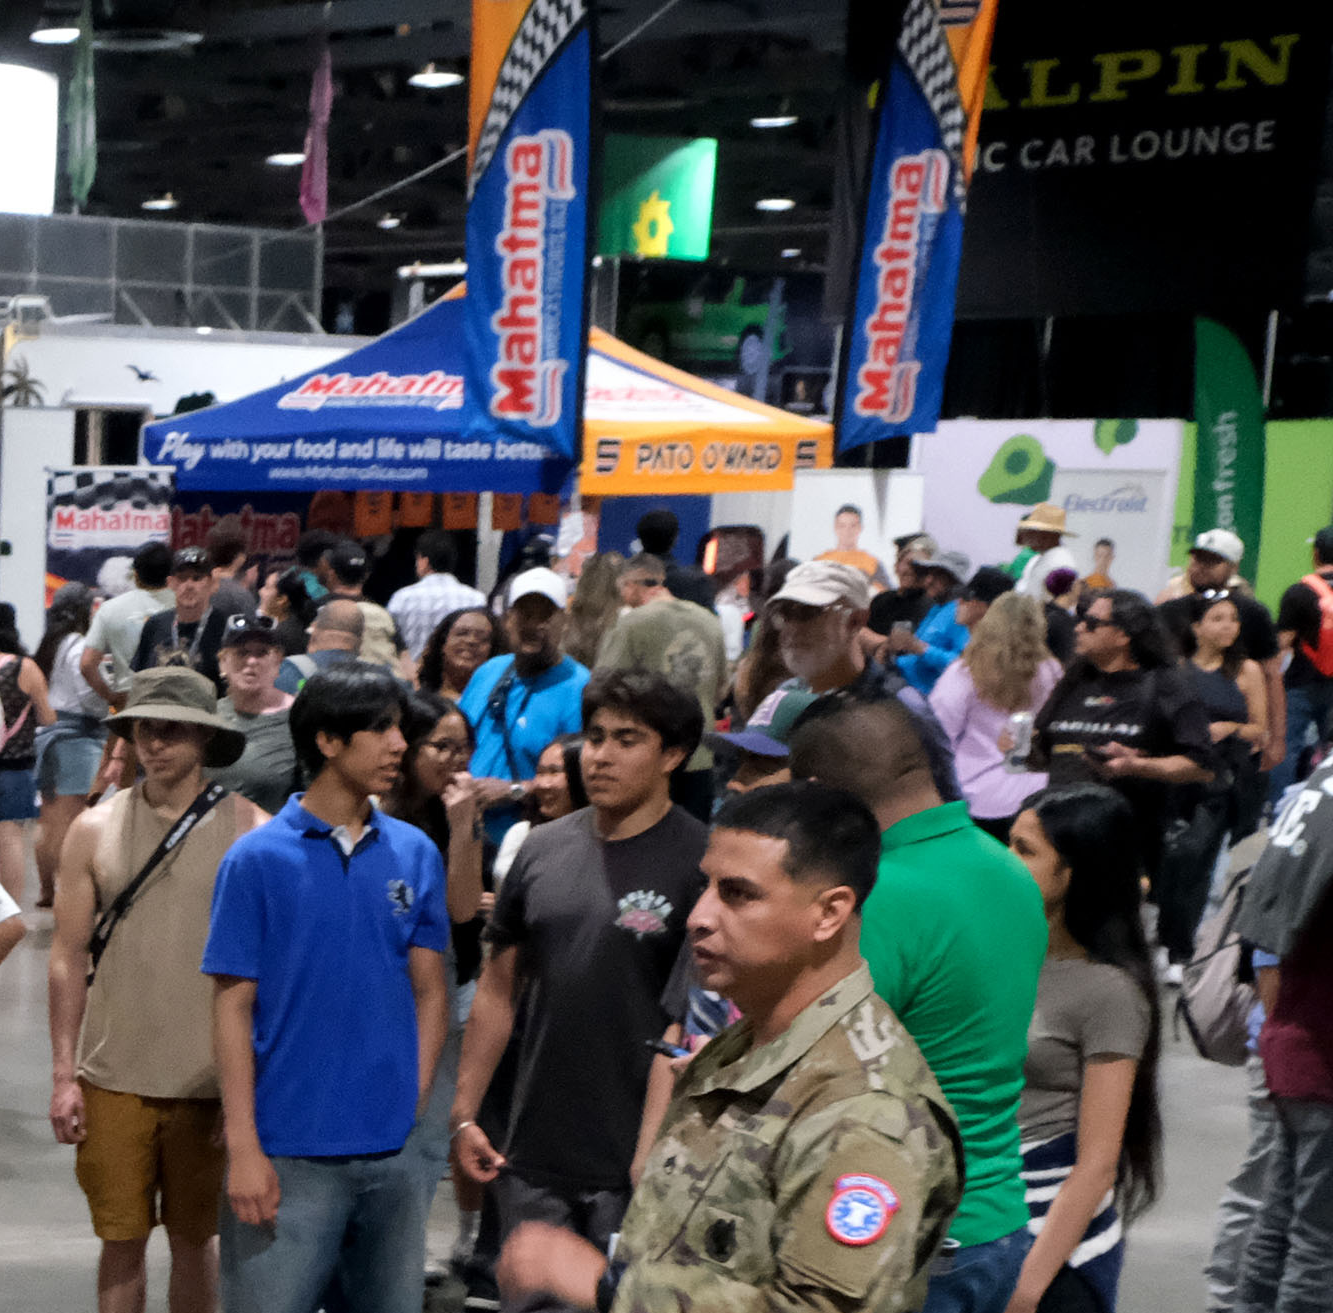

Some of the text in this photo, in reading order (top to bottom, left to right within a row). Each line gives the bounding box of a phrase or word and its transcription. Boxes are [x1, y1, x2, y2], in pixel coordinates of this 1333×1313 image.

[1019, 134, 1096, 170] CAR
[1109, 119, 1277, 163] LOUNGE
[496, 142, 545, 413] Mahatma
[859, 162, 927, 411] Mahatma
[299, 371, 464, 395] Mahatm
[156, 431, 206, 472] Play
[210, 439, 250, 460] with
[251, 442, 293, 465] your
[294, 438, 337, 460] food
[337, 438, 375, 460] and
[377, 437, 406, 460] life
[408, 438, 442, 460] will
[444, 440, 492, 461] taste
[634, 442, 696, 473] PATO
[55, 509, 171, 532] Mahatma
